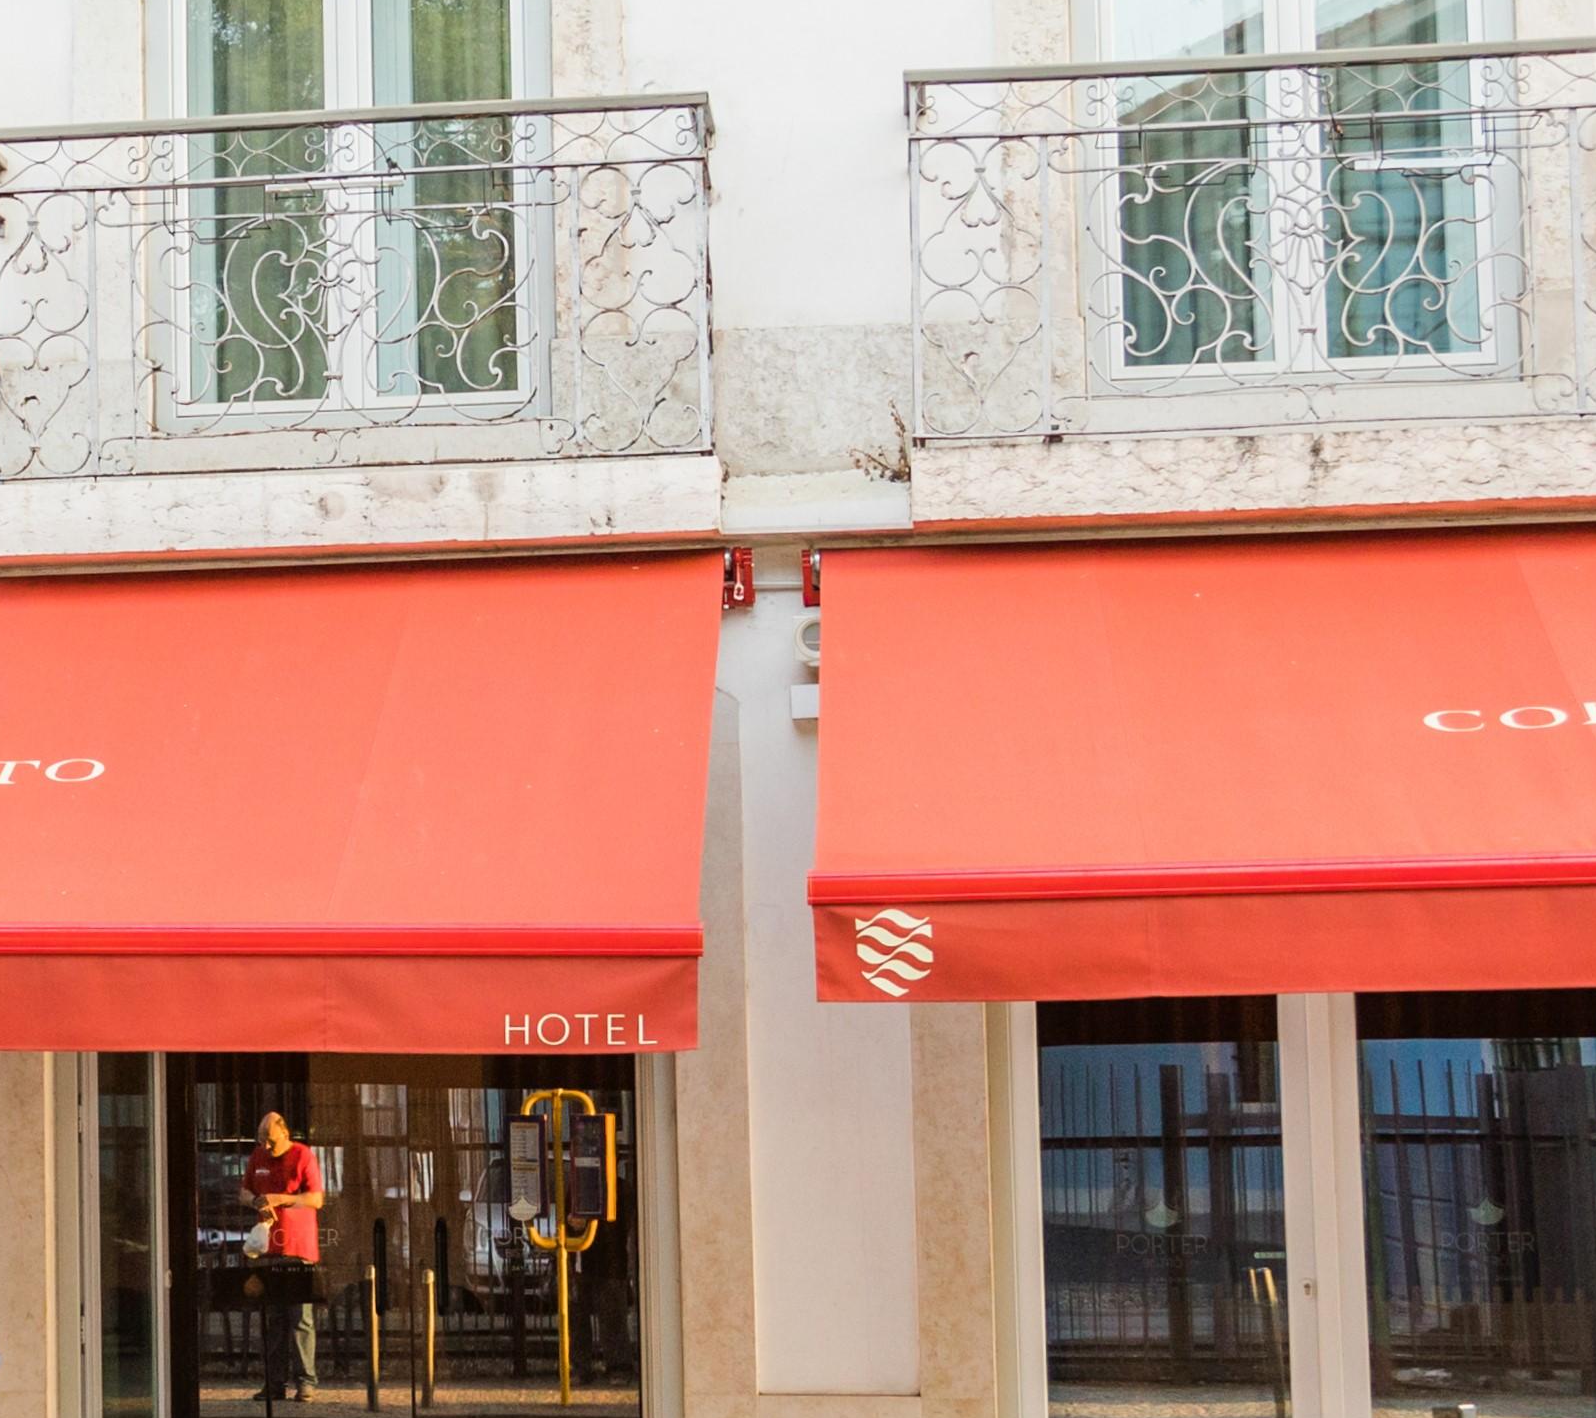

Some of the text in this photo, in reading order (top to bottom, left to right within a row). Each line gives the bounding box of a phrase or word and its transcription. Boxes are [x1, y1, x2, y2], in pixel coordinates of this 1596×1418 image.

[504, 1011, 659, 1046] HOTEL
[1115, 1233, 1209, 1255] PORTER
[1440, 1231, 1536, 1253] PORTER
